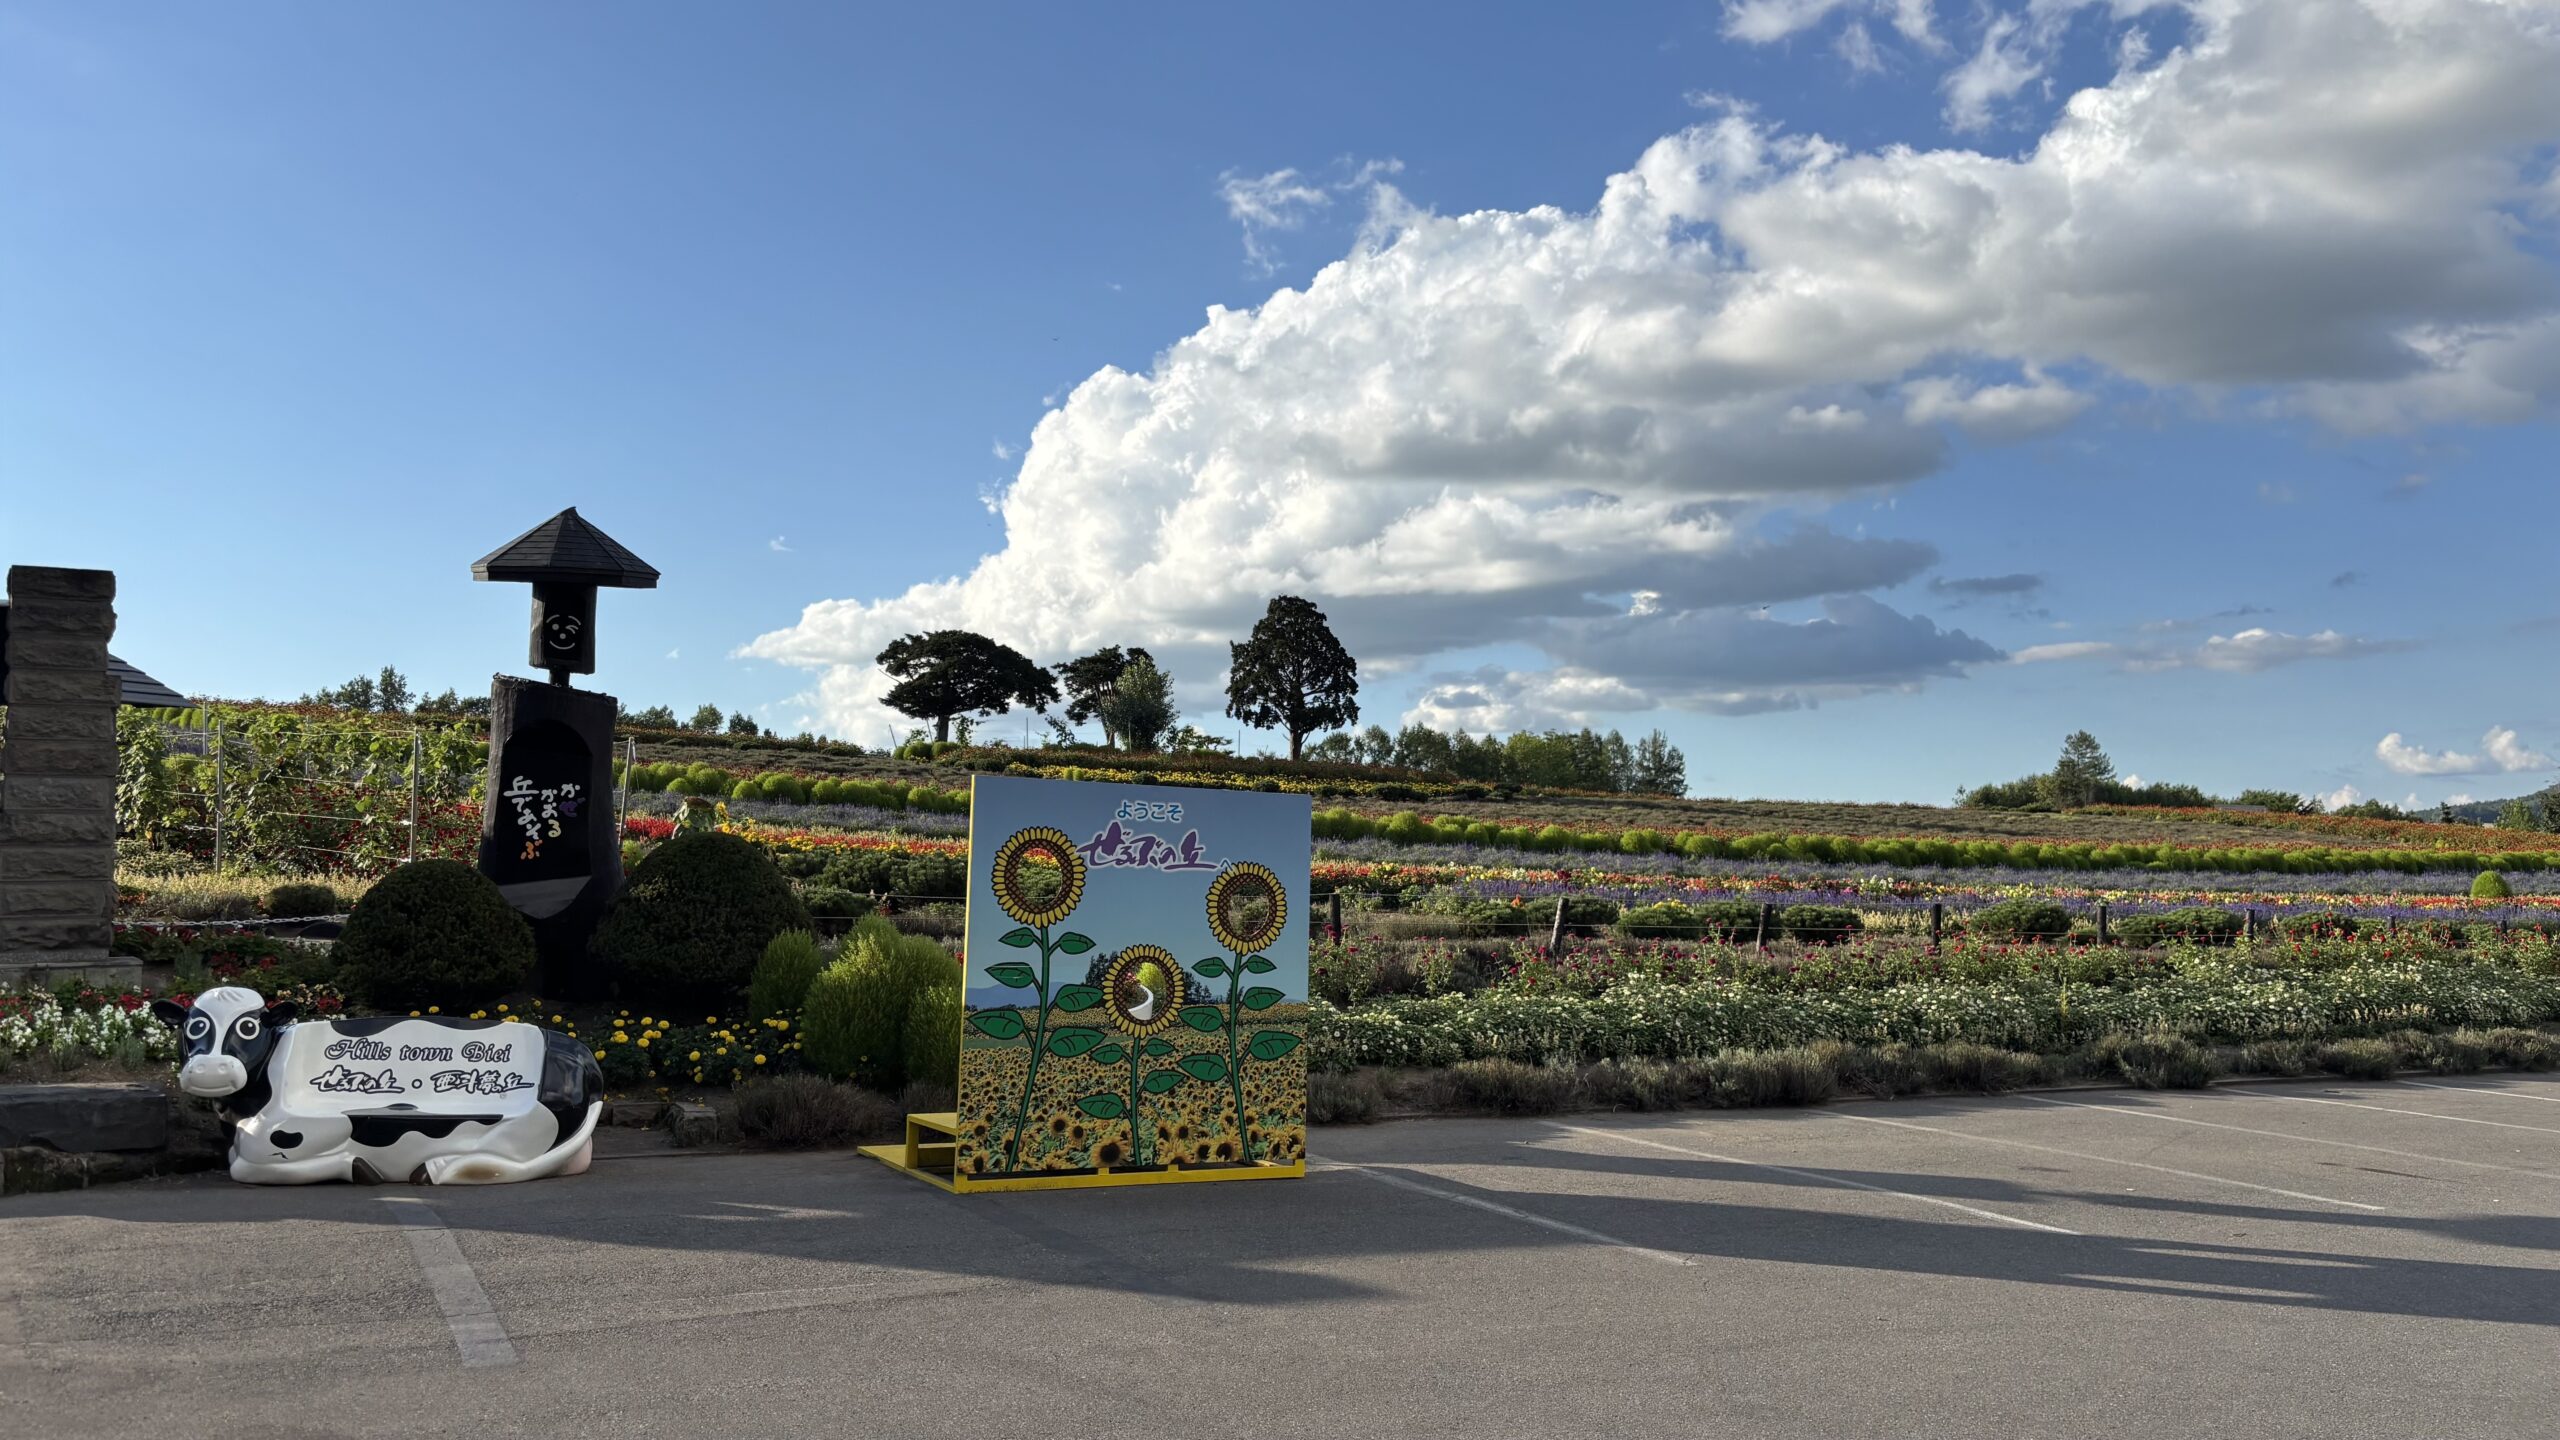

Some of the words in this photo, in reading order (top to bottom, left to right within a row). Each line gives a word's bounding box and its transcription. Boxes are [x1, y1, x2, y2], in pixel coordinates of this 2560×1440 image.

[540, 788, 562, 838] かおる
[559, 783, 586, 817] かぜ
[1115, 800, 1185, 822] ようこそ
[503, 775, 544, 860] 丘であそぶ
[324, 1038, 392, 1061] Hills
[399, 1044, 453, 1062] town
[461, 1041, 512, 1063] Biei
